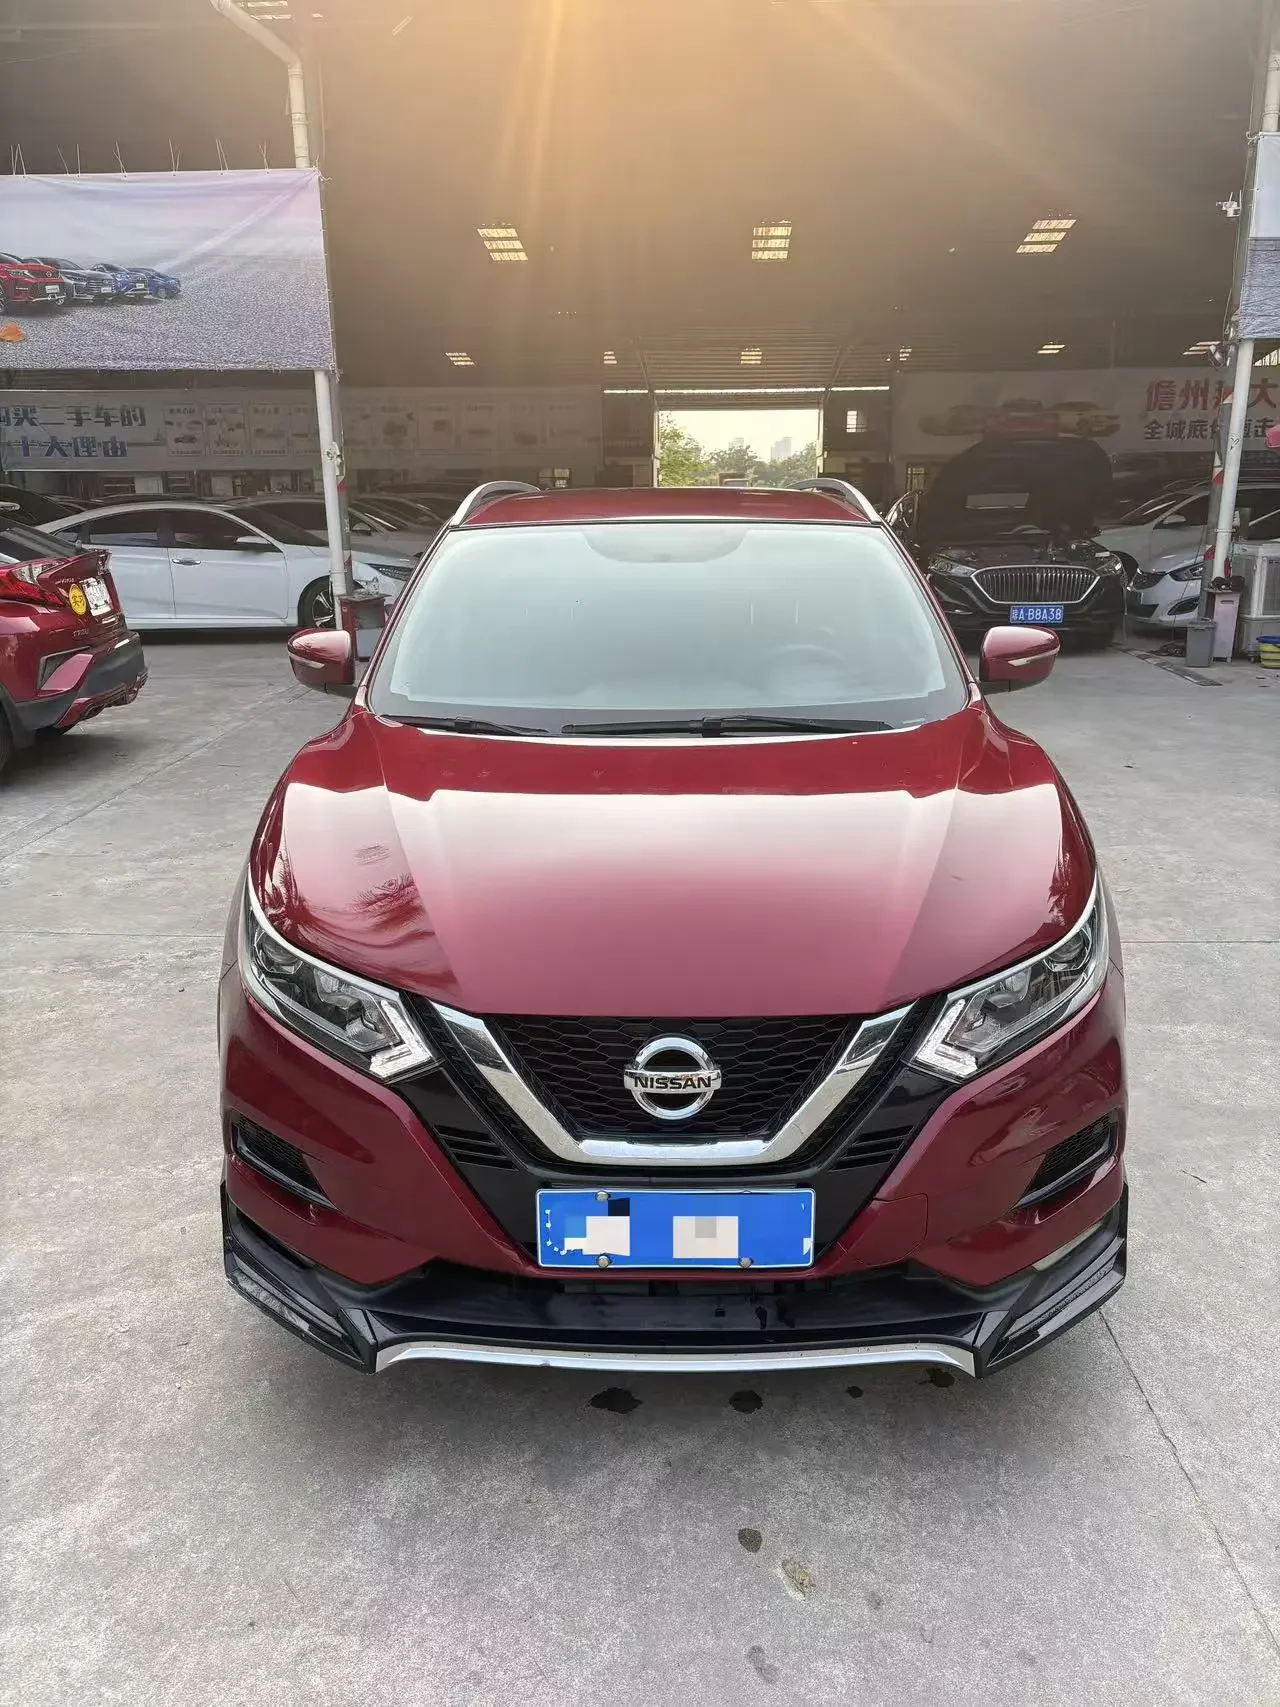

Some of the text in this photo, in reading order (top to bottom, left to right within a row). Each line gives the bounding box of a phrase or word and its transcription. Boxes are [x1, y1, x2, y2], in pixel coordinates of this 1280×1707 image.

[1146, 378, 1279, 411] 儋州大
[8, 435, 128, 457] 十大理由
[634, 1075, 712, 1090] NISSAN
